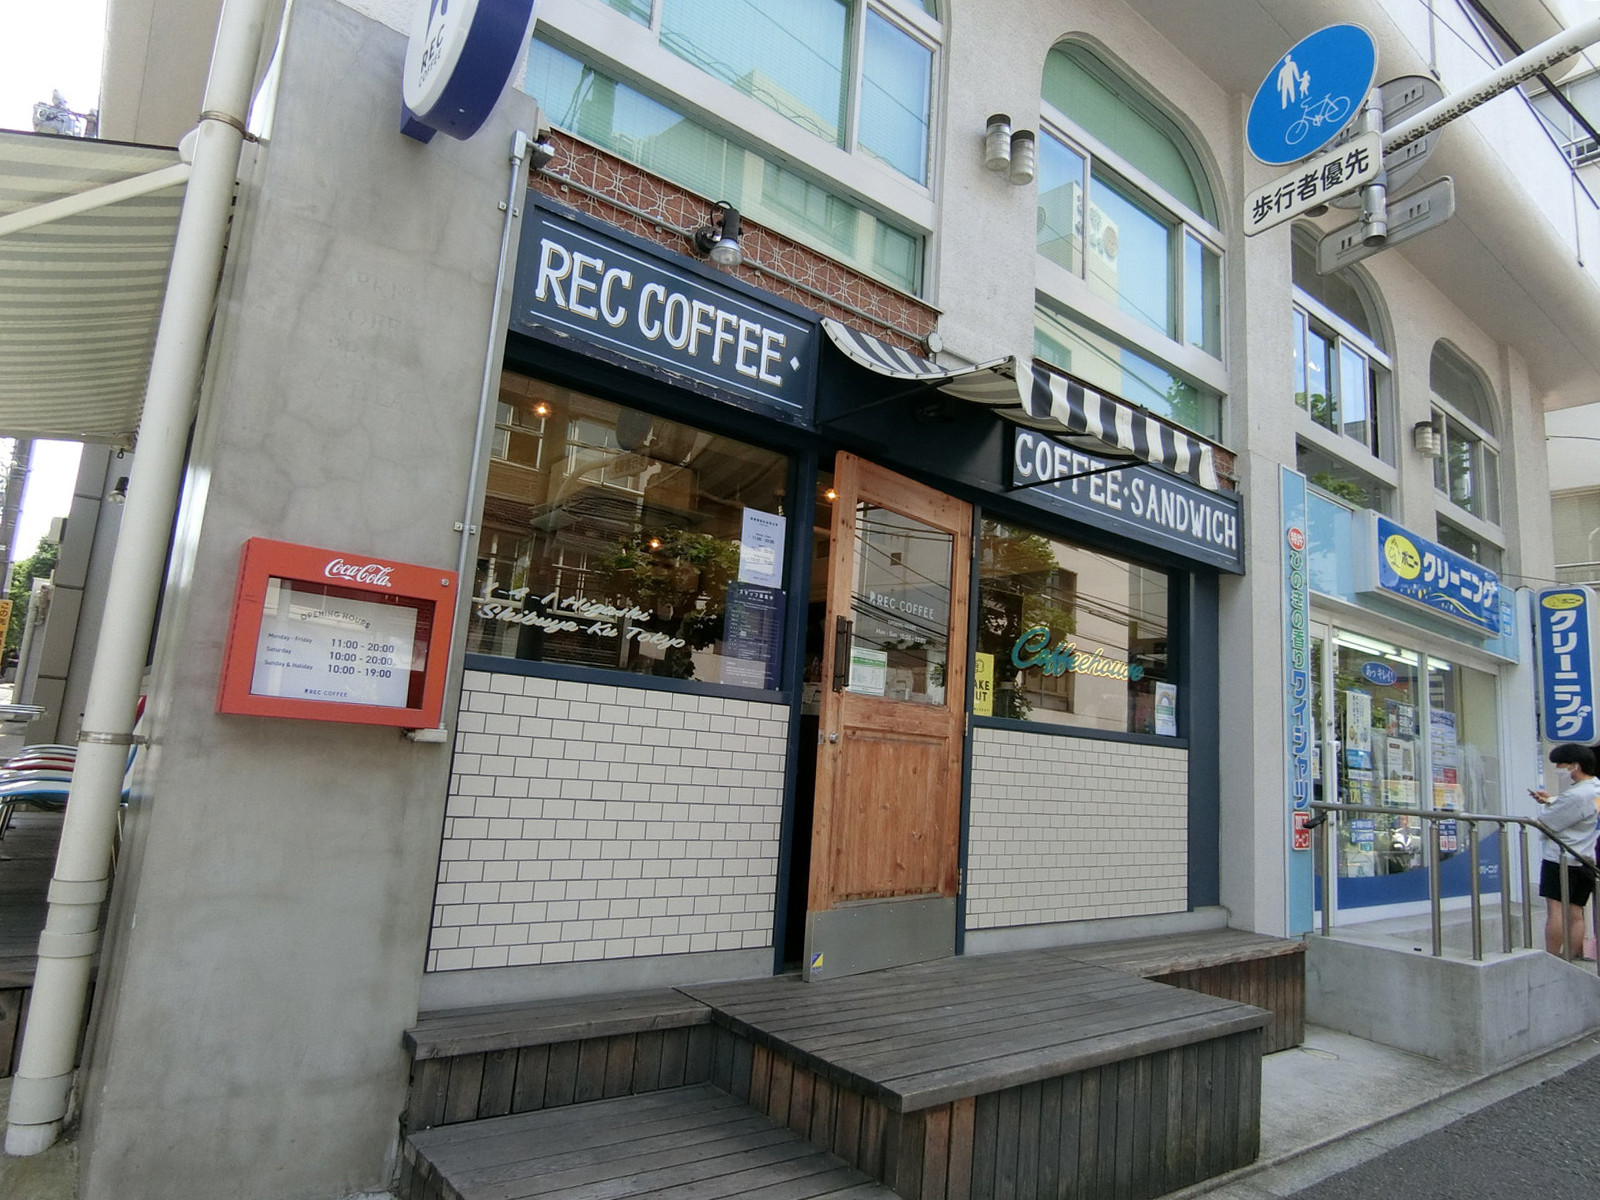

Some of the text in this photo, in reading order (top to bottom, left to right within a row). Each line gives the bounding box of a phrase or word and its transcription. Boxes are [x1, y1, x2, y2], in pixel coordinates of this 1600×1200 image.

[421, 24, 445, 72] REC
[1252, 147, 1370, 225] 歩行者優先
[535, 238, 787, 388] REC COFFEE
[1014, 433, 1238, 551] COFFEE SANDWICH
[324, 558, 395, 587] Coca-Cola
[1423, 552, 1499, 608] クリーニング
[561, 595, 653, 622] Higashi
[877, 594, 935, 620] REC COFFEE
[300, 610, 371, 630] OPENING HOURS
[268, 632, 290, 641] Monday
[295, 636, 313, 644] Friday
[331, 638, 358, 650] 11:00
[367, 642, 395, 653] 20:00
[625, 625, 686, 650] Tokyo
[266, 646, 292, 655] Saturday
[329, 651, 357, 662] 10:00
[366, 655, 393, 666] 20:00
[1011, 625, 1146, 681] Coffeehouse
[264, 659, 285, 668] Sunday
[328, 664, 355, 675] 10:00
[365, 668, 392, 679] 19:00
[1550, 609, 1592, 737] クリーニング
[974, 679, 990, 691] AKE
[975, 691, 988, 702] UT
